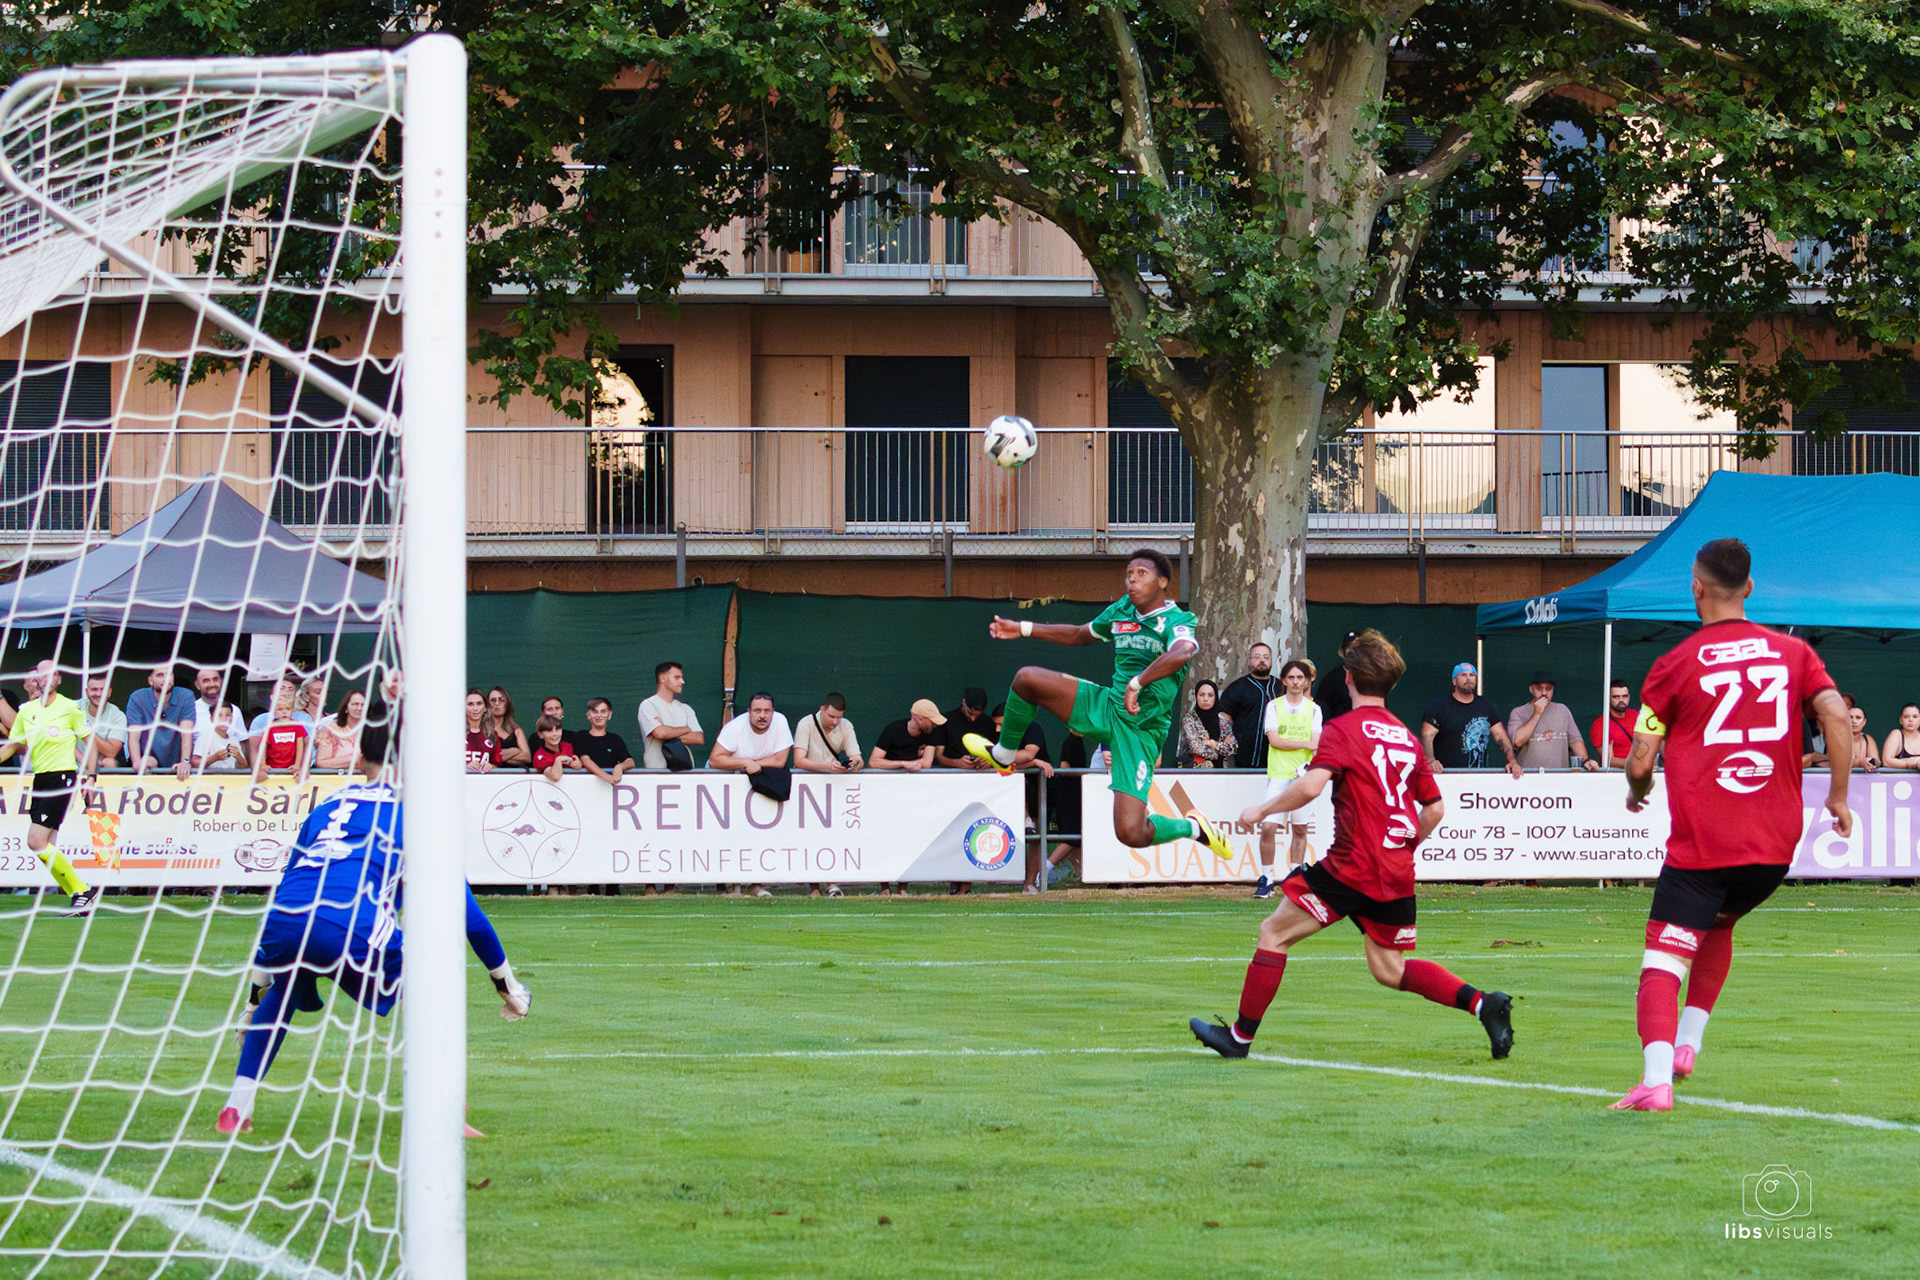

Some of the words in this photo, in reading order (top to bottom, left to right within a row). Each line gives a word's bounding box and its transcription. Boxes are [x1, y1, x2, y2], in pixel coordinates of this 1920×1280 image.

[1697, 637, 1782, 667] GBBL
[1699, 664, 1789, 747] 23
[1370, 743, 1417, 810] 17
[1717, 765, 1775, 779] TES
[246, 786, 319, 815] Sàrl
[612, 783, 833, 831] RENON
[841, 782, 862, 830] SÀRL
[1459, 792, 1573, 810] Showroom
[193, 819, 251, 832] Robero
[257, 819, 277, 832] De
[1439, 826, 1477, 839] Cour
[1483, 826, 1506, 839] 78
[1526, 825, 1566, 839] 1007
[1572, 825, 1650, 839] Lausanne
[145, 842, 198, 855] suise
[612, 842, 862, 874] DÉSINFECTION
[1421, 847, 1457, 861] 624
[1463, 847, 1487, 861] 05
[1493, 847, 1515, 861] 37
[1533, 846, 1665, 861] www.suarato.ch
[15, 856, 36, 870] 23
